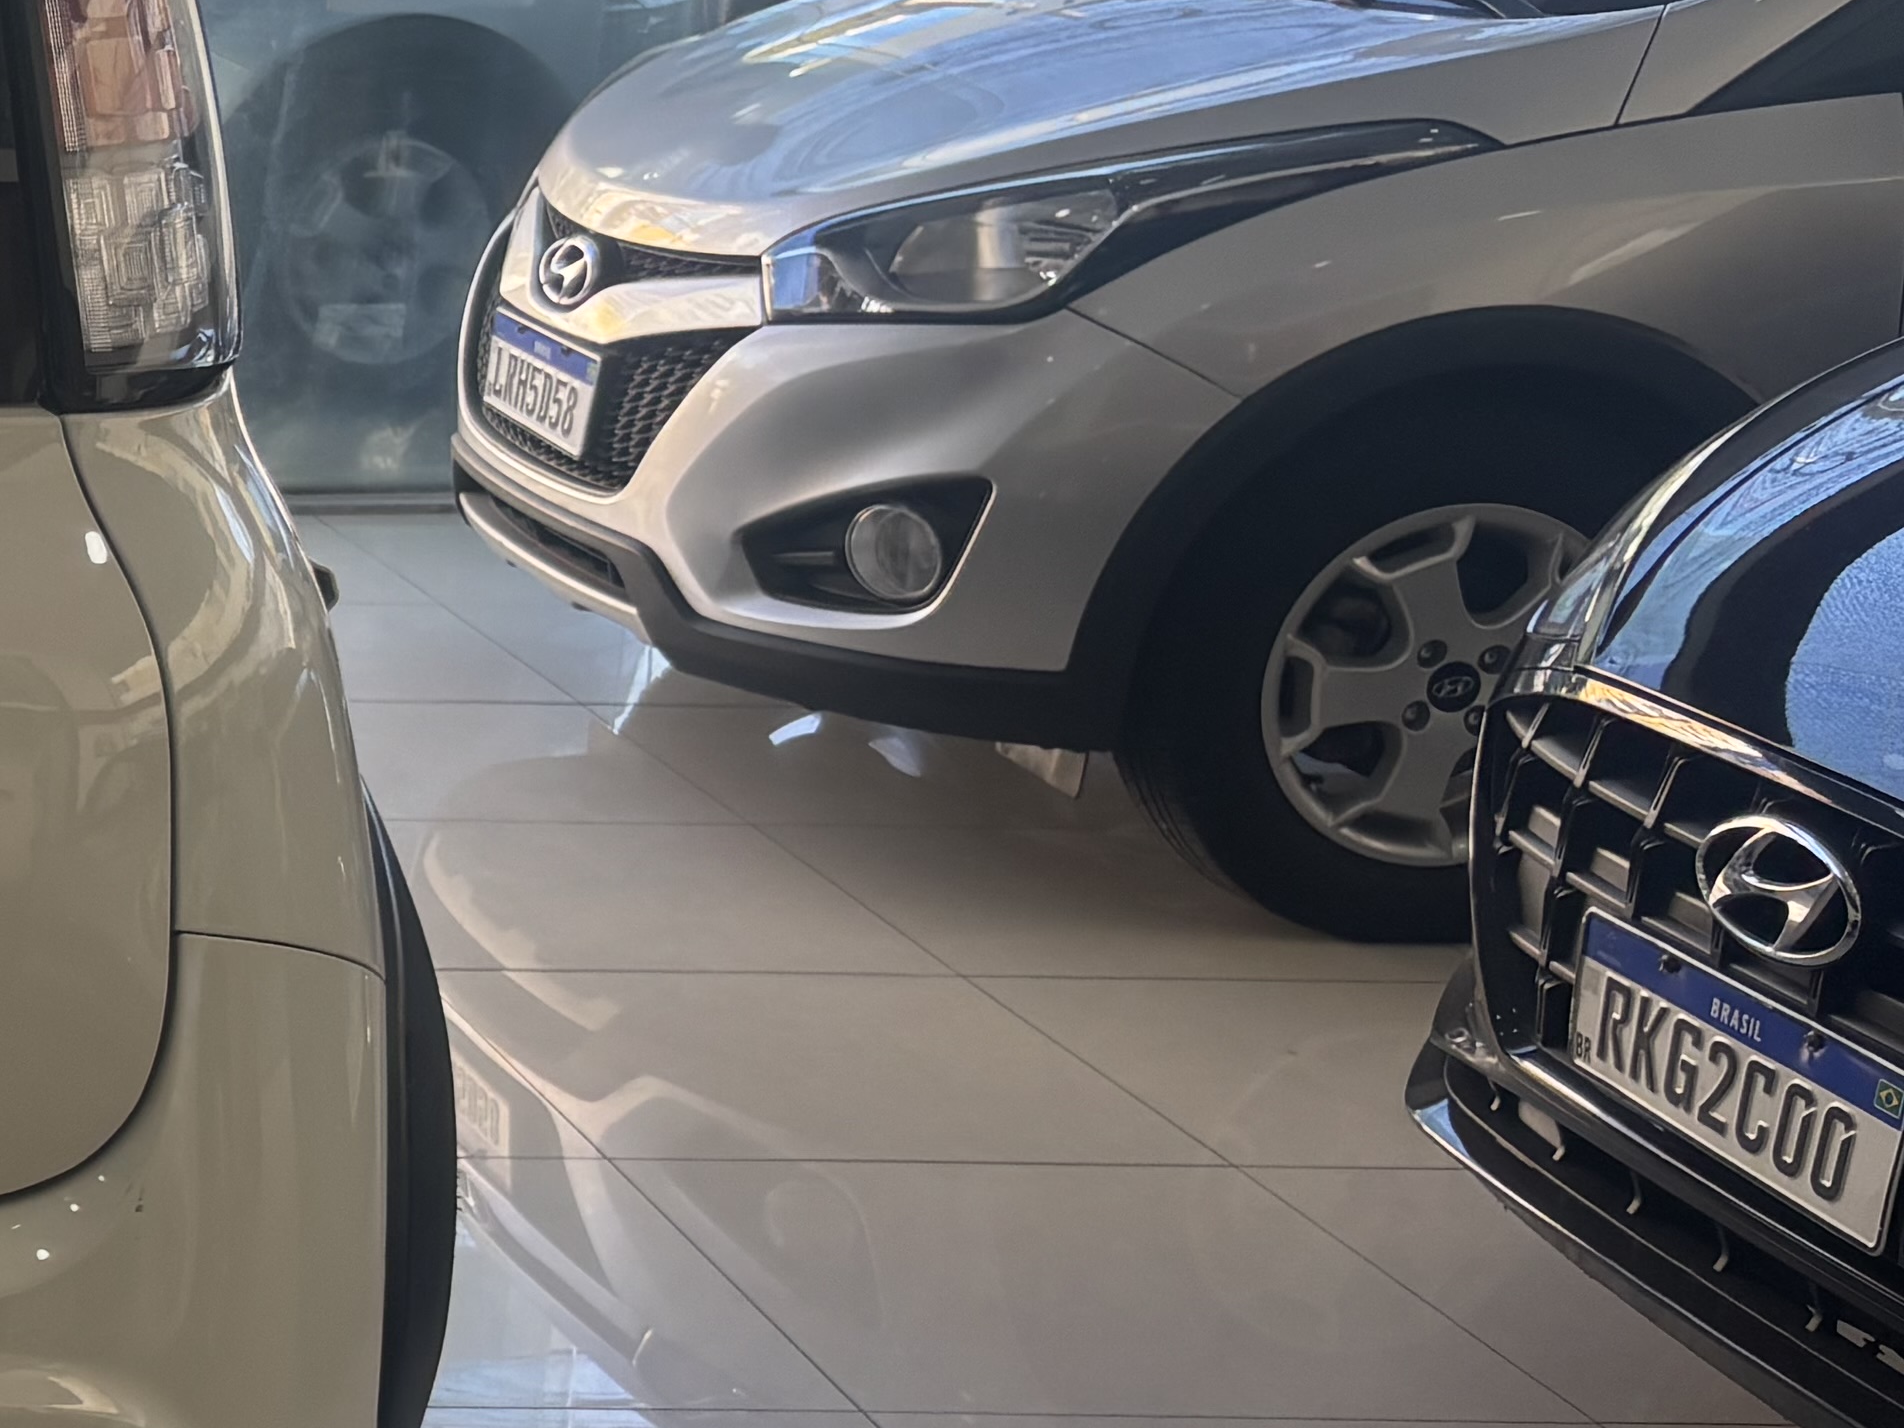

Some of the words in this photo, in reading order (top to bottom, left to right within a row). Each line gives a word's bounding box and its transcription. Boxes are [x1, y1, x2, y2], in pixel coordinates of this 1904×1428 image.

[1709, 997, 1763, 1044] BRASIL
[1575, 1030, 1593, 1062] BR
[1596, 975, 1858, 1202] RKG2C00
